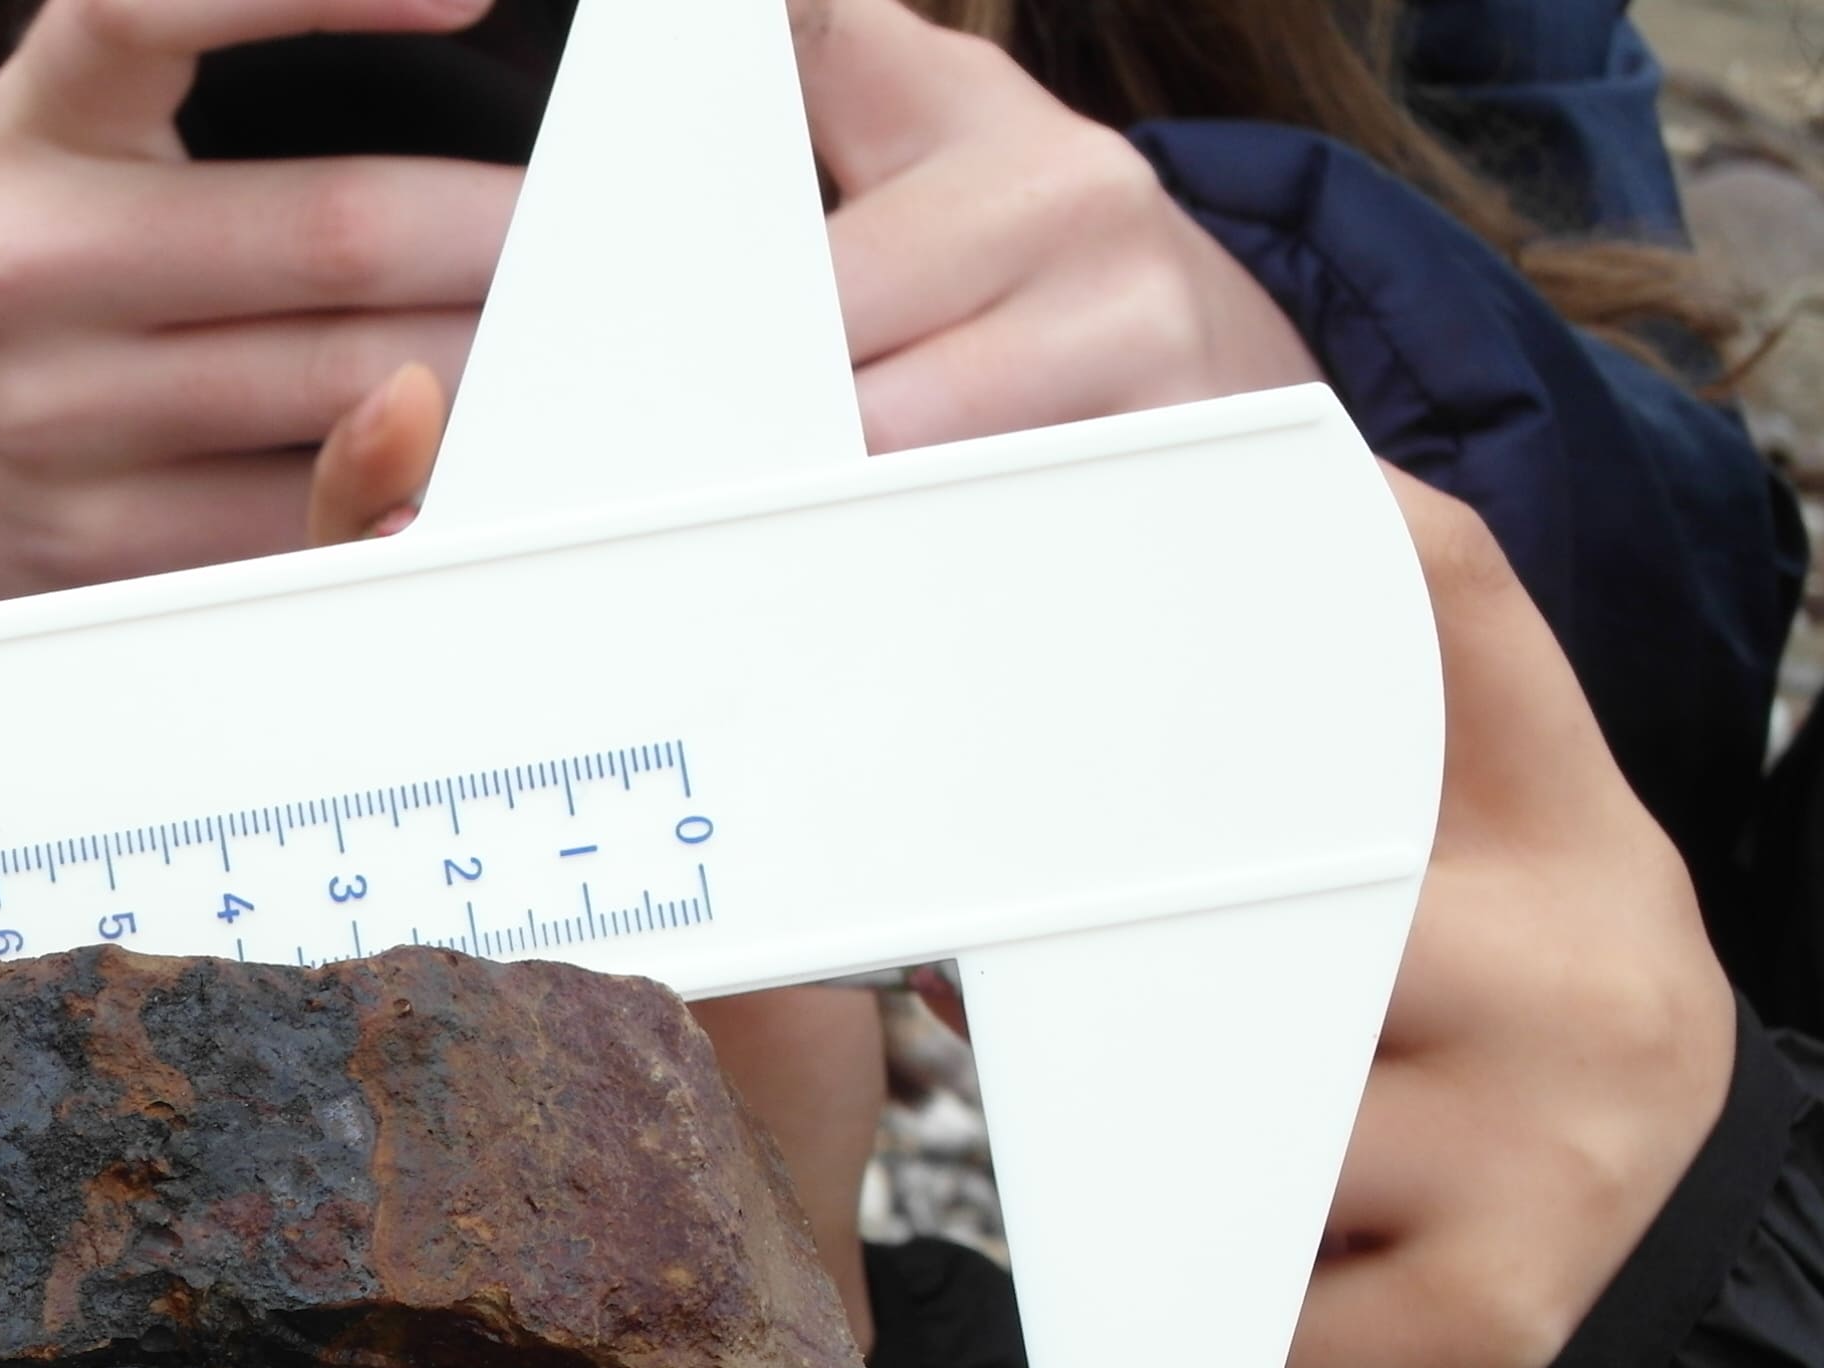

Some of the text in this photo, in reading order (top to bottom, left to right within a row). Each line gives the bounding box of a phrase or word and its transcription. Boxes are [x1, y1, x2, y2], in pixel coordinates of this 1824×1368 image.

[673, 814, 715, 846] 0
[558, 843, 601, 859] 1
[442, 856, 484, 886] 2
[327, 874, 369, 904] 3
[215, 892, 256, 924] 4
[96, 911, 139, 941] 5
